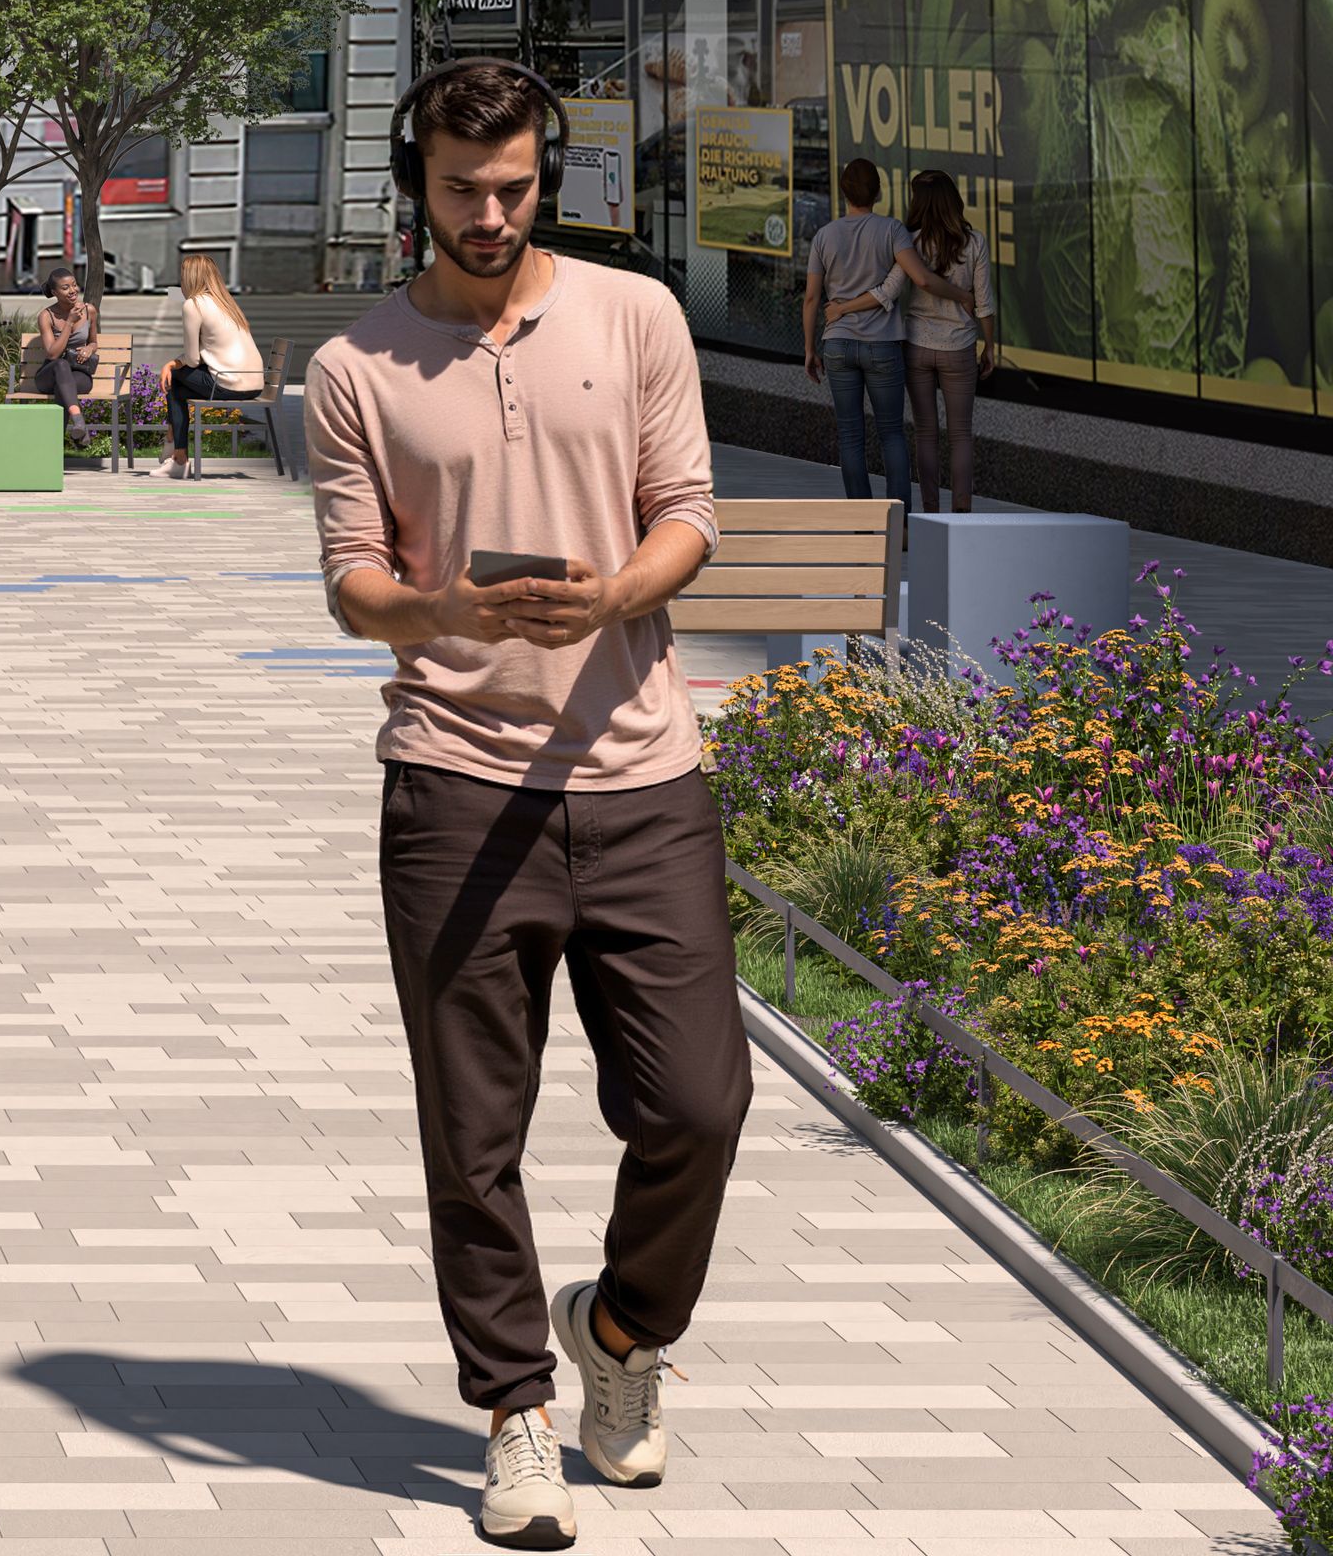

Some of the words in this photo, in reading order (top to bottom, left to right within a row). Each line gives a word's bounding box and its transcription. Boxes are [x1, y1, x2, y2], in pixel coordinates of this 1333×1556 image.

[841, 64, 1004, 156] VOLLER
[701, 149, 722, 162] DIE
[724, 150, 782, 168] RICHTIGE
[701, 166, 759, 184] HALTUNG
